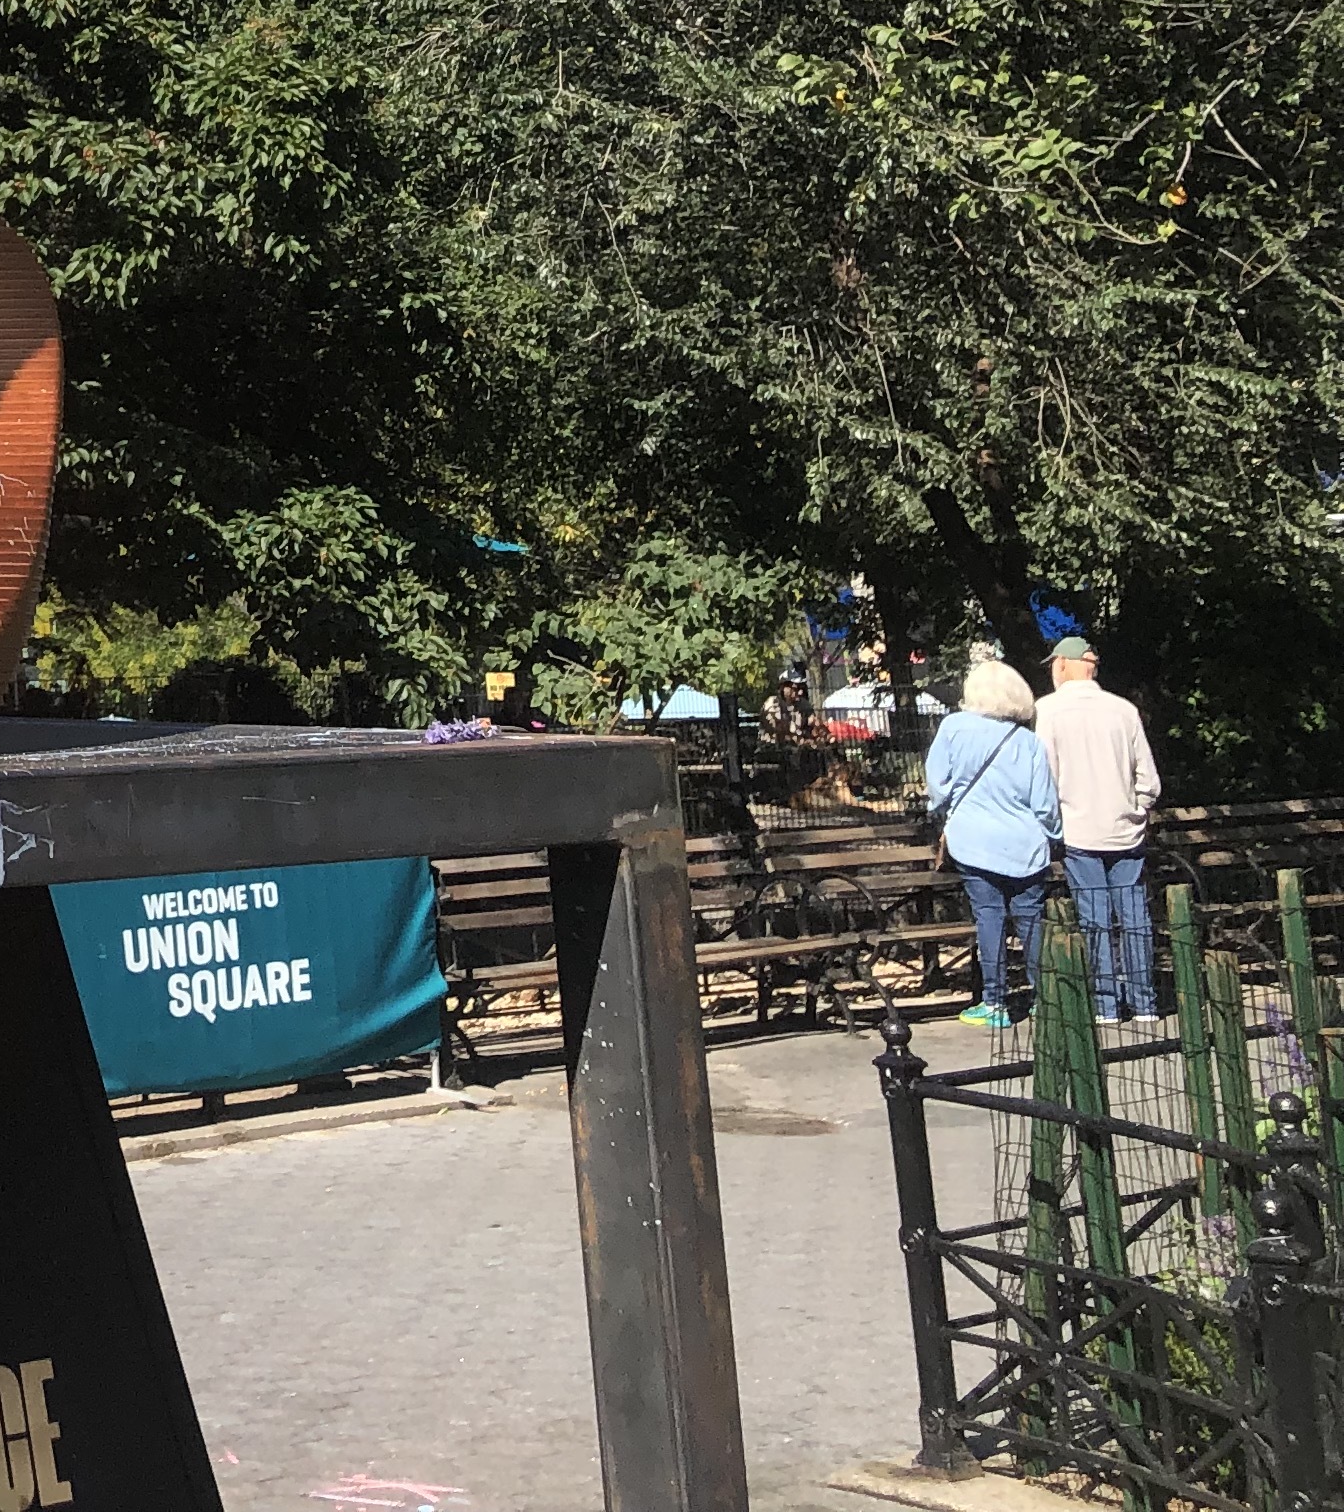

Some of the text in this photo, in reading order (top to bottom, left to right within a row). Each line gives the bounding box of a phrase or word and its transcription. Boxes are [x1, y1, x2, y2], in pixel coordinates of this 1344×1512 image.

[142, 881, 279, 920] WELCOME TO
[122, 918, 240, 973] UNION
[167, 958, 313, 1024] SQUARE
